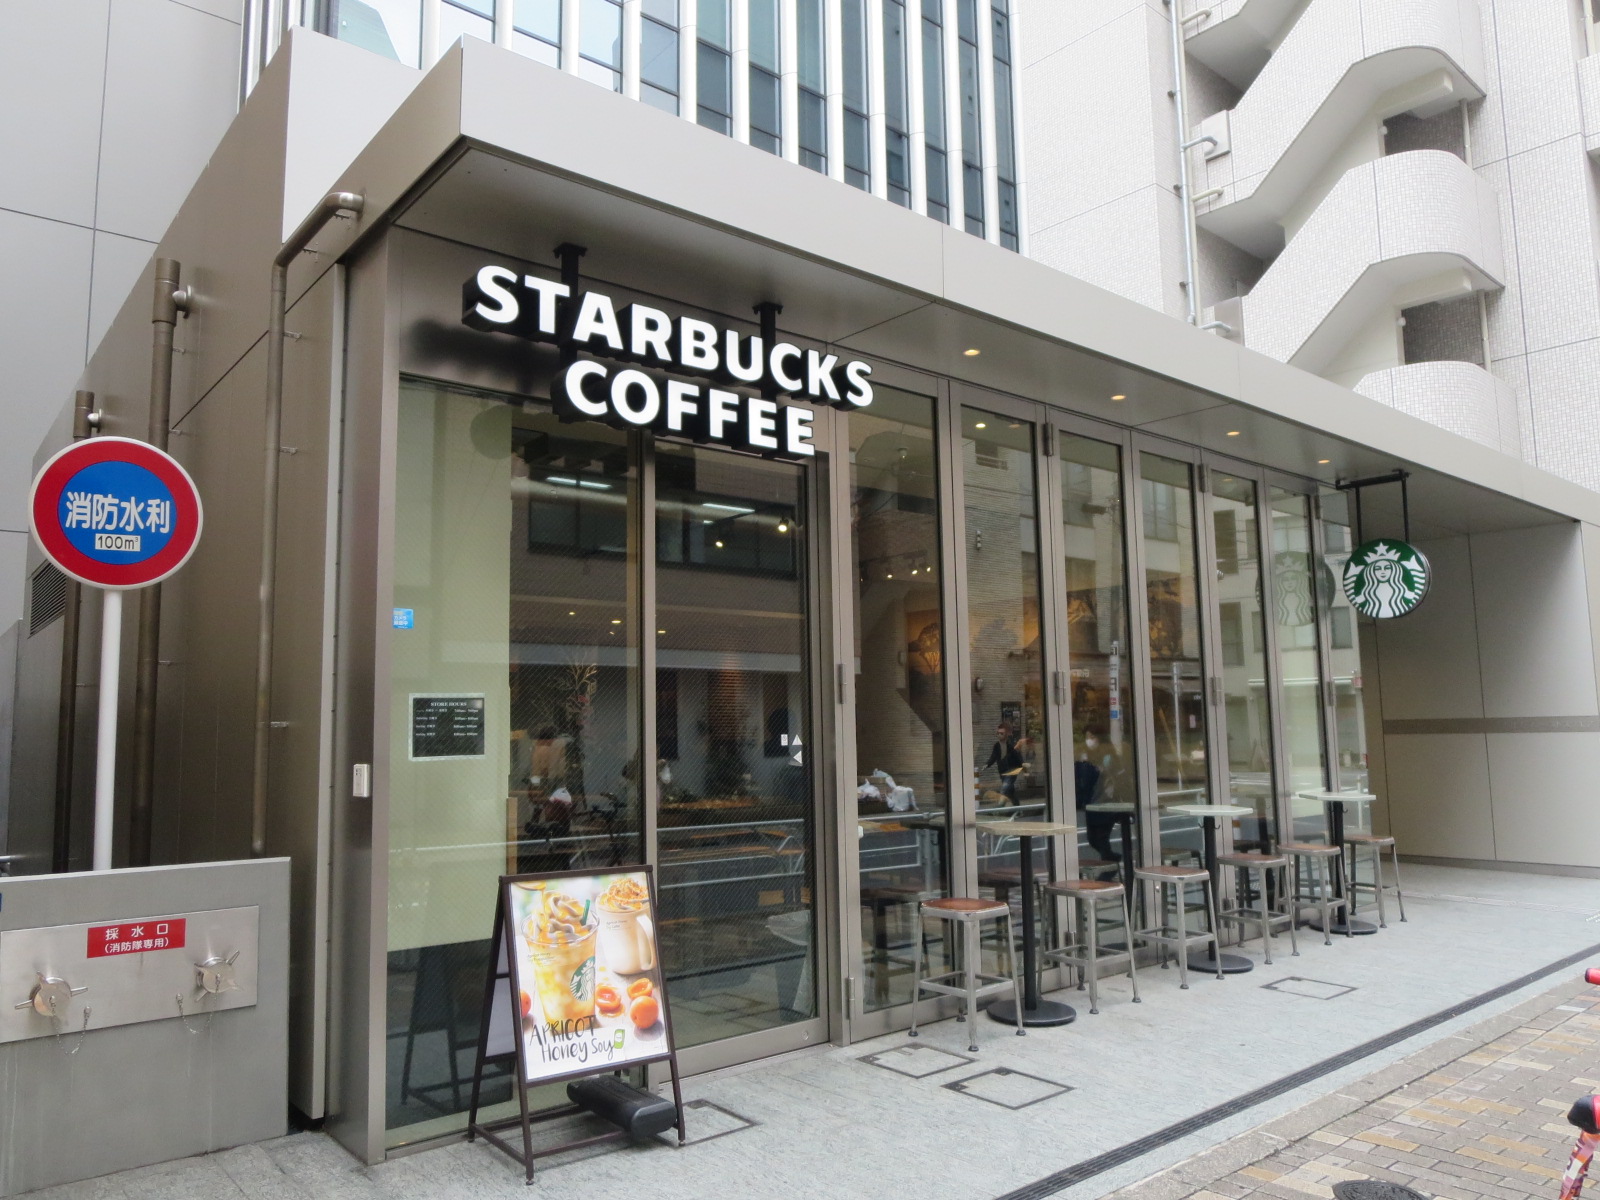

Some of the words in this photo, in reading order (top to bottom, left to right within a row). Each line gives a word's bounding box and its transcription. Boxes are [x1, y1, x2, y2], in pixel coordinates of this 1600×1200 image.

[475, 265, 874, 408] STARBUCKS
[565, 359, 815, 456] COFFEE
[65, 491, 170, 534] 消防水利
[529, 1014, 597, 1046] APRICOT
[541, 1040, 588, 1063] Honey
[591, 1037, 615, 1061] Soy
